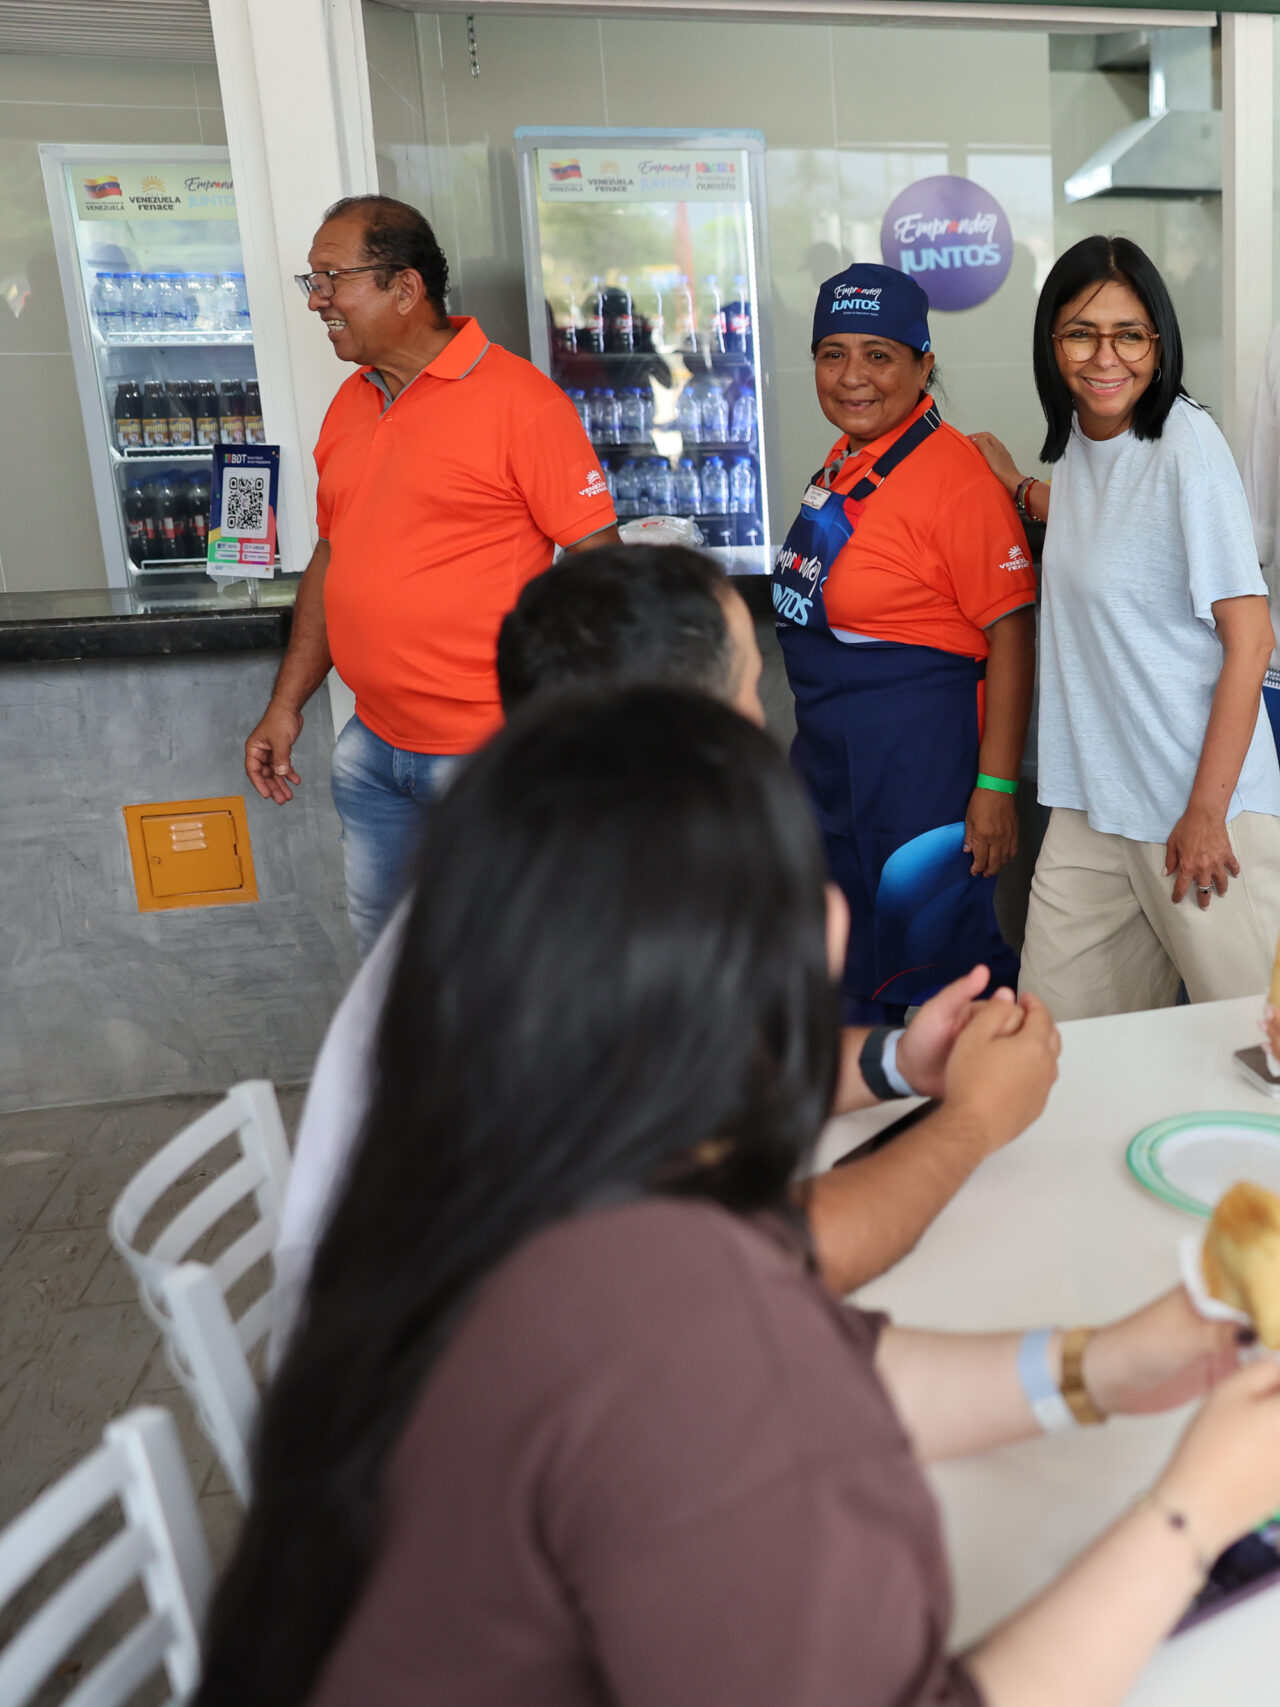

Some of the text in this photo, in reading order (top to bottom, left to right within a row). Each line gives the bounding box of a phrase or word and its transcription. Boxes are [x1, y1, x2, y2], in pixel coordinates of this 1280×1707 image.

[588, 178, 634, 186] VENEZUELA
[129, 196, 181, 204] VENEZUELA
[188, 195, 236, 209] JUNTO
[138, 203, 174, 211] renace
[900, 243, 1001, 275] JUNTOS
[831, 299, 880, 313] JUNTOS
[231, 453, 247, 464] BDT
